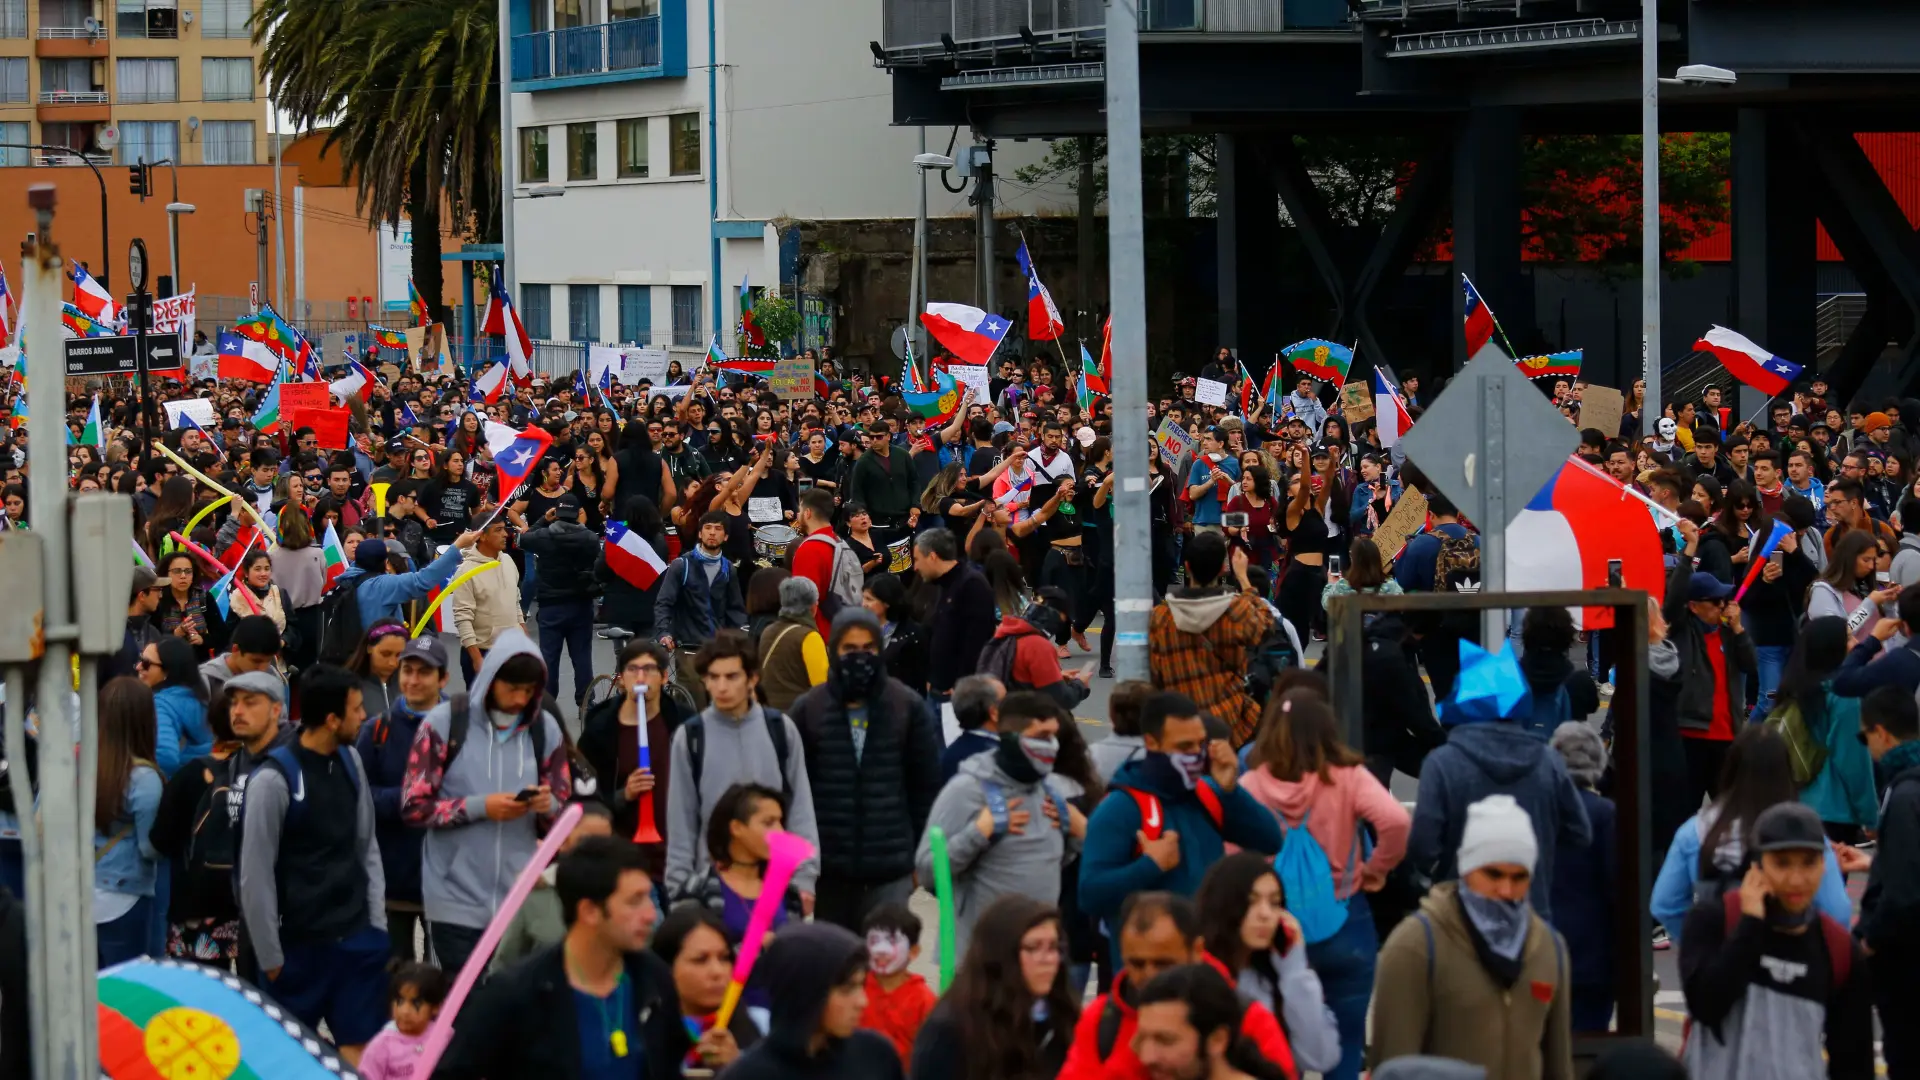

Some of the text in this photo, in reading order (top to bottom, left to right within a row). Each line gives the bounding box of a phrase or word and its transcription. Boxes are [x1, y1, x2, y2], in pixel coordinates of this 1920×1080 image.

[69, 346, 113, 356] BARROS ARANA
[69, 359, 133, 371] 0098 0002
[1166, 421, 1193, 446] PARCHES
